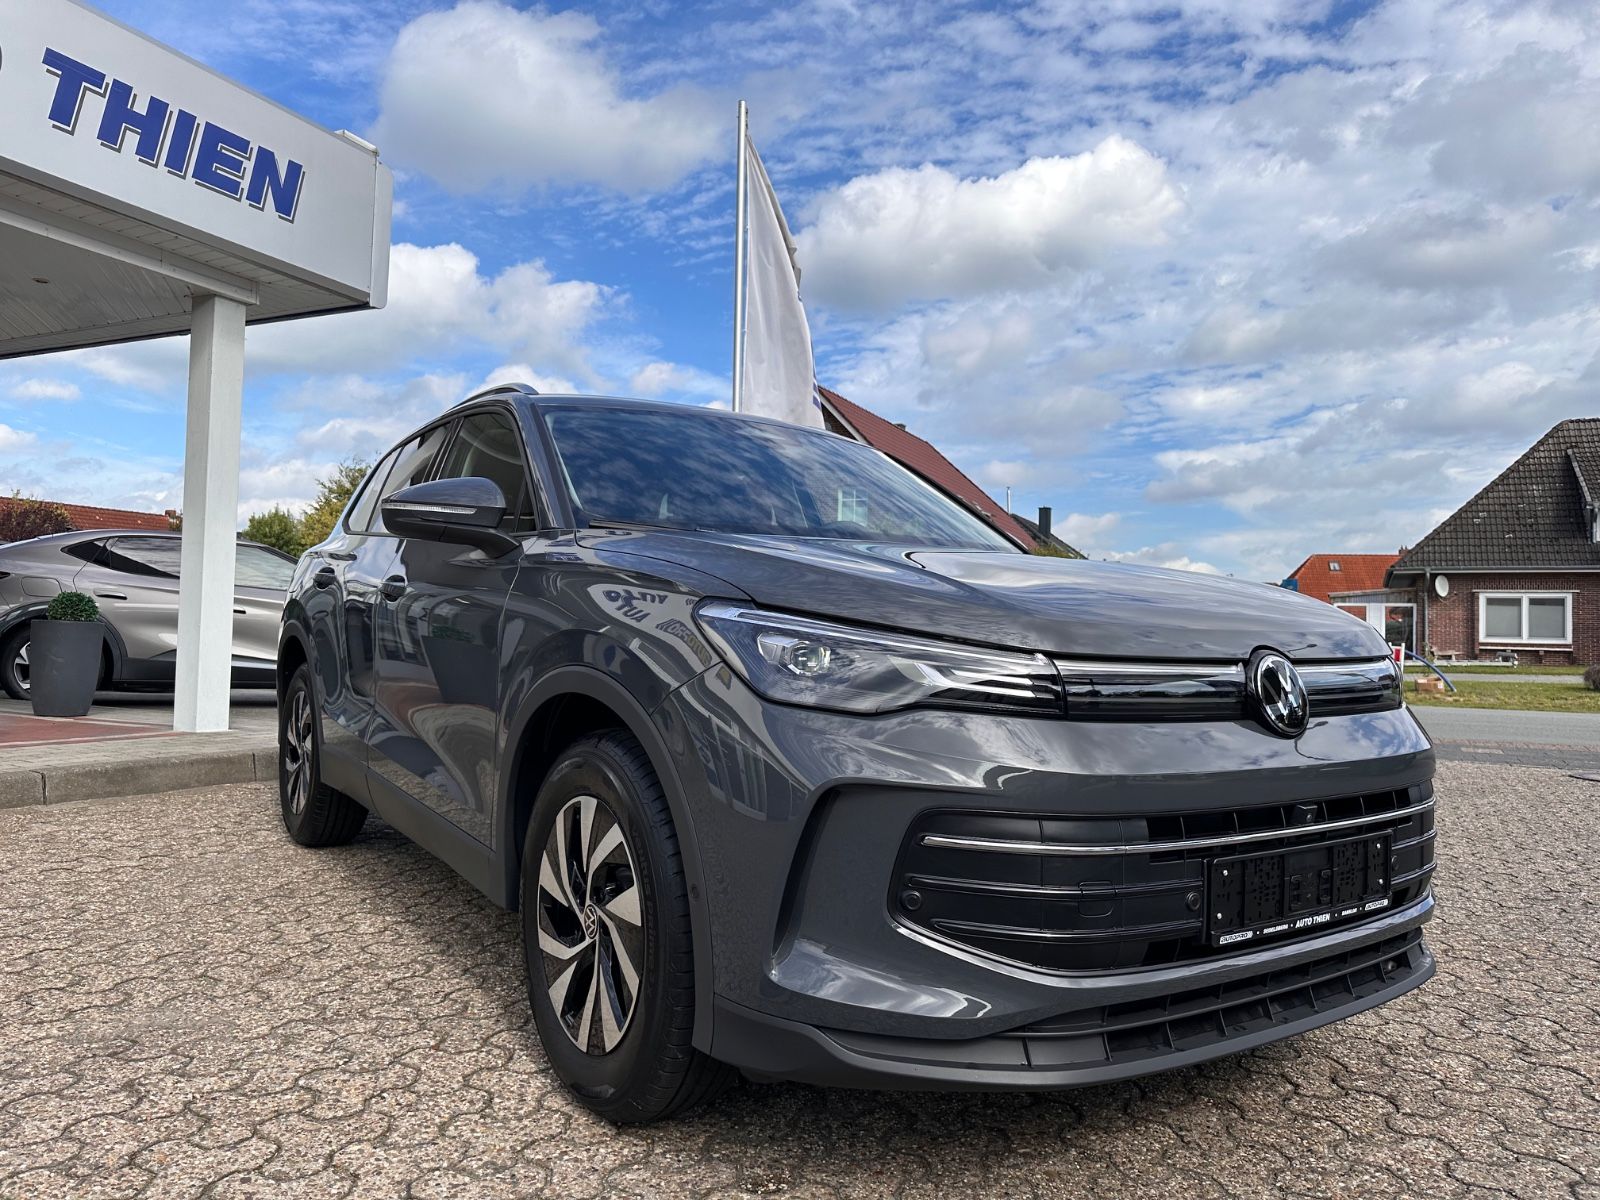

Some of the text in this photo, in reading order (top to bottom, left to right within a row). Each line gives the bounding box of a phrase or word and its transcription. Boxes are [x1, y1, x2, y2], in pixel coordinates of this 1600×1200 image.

[42, 47, 305, 223] THIEN
[1295, 917, 1312, 928] AUTO
[1313, 913, 1330, 924] THIEN
